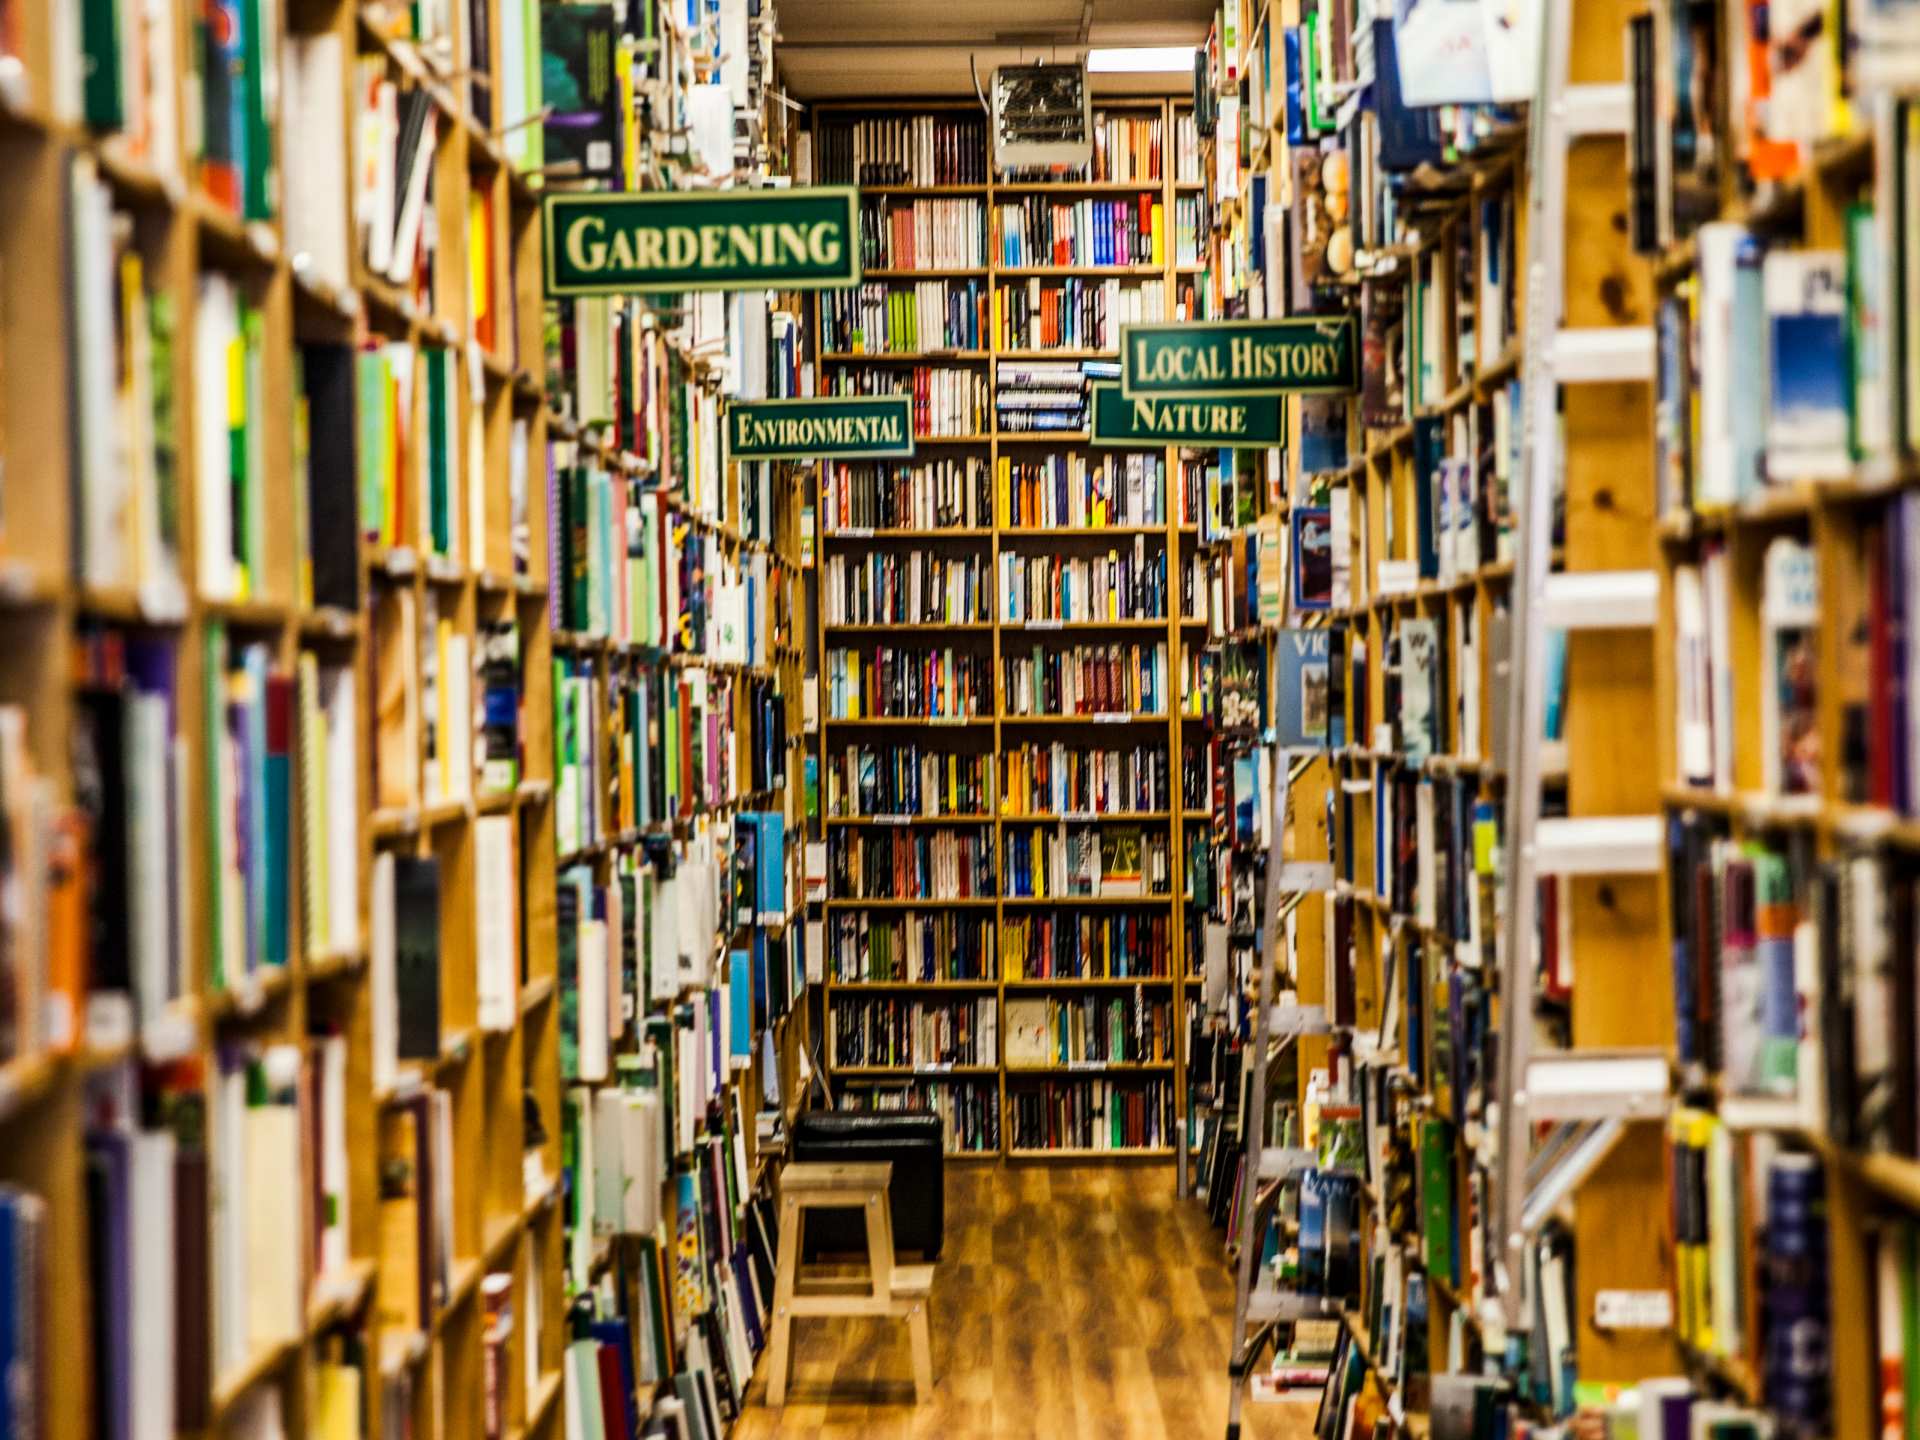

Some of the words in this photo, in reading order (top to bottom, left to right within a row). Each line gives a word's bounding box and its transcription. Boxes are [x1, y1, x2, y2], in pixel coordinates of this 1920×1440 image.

[566, 216, 841, 272] GARDENING
[1137, 339, 1226, 382] LOCAL
[1231, 337, 1342, 378] HISTORY
[738, 413, 903, 447] ENVIRONMENTAL
[1132, 399, 1247, 433] NATURE
